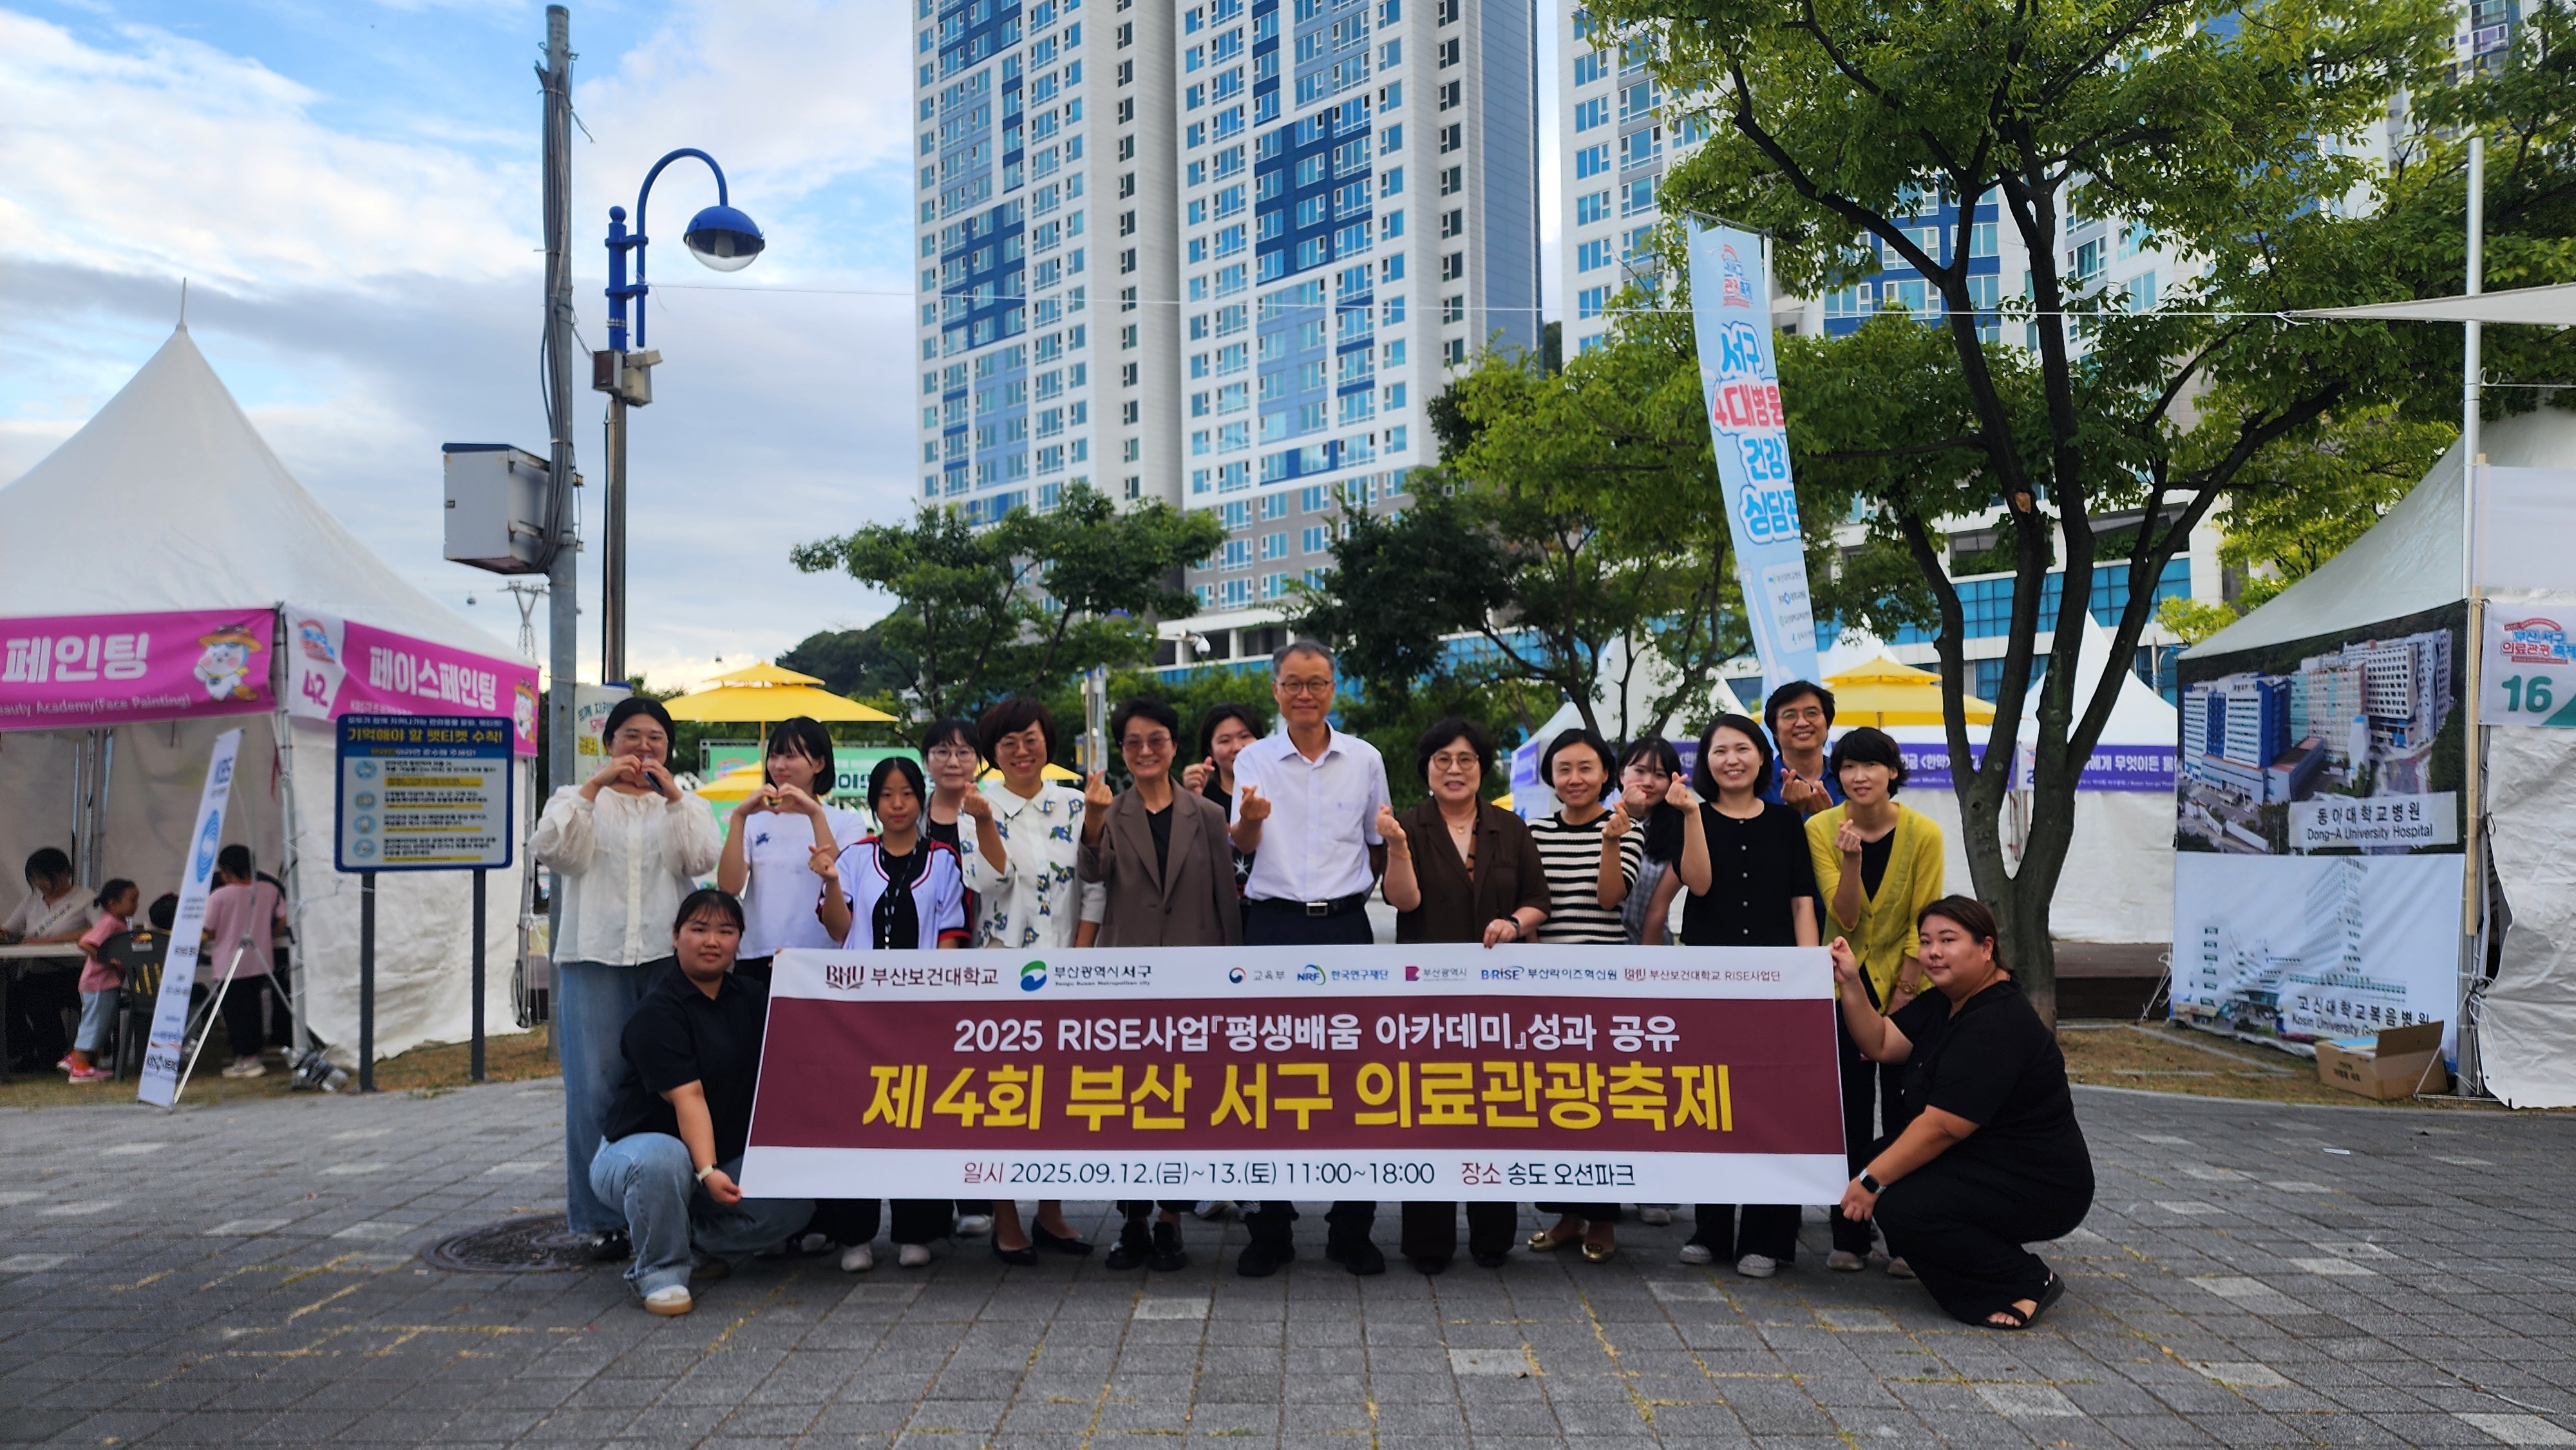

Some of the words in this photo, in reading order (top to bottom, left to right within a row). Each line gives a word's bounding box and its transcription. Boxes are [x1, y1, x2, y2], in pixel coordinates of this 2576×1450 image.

[1721, 330, 1759, 374] 서구
[1744, 438, 1785, 480] 건강
[2, 632, 149, 683] 페인팅
[302, 669, 328, 707] 42
[369, 646, 497, 711] 페이스페인팅
[2501, 675, 2552, 713] 16
[0, 702, 30, 718] eauty
[2084, 755, 2112, 771] 에게
[2115, 755, 2159, 772] 무엇이든
[2318, 802, 2420, 825] 동아대학교병원
[2308, 827, 2342, 842] Dong-A
[2345, 827, 2389, 840] University
[2393, 824, 2432, 838] Hospital
[871, 967, 999, 987] 부산보건대학교
[1055, 966, 1119, 979] 부산광역시
[1122, 965, 1152, 978] 서구
[1253, 970, 1285, 981] 교육부
[1297, 972, 1320, 981] NRF
[1331, 970, 1388, 981] 한국연구재단
[1424, 968, 1466, 977] 부산광역시
[1528, 968, 1617, 980] 부산라이즈혁신원
[1650, 970, 1721, 981] 부산보건대학교
[1725, 970, 1780, 982] RISE사업단
[954, 1019, 1043, 1051] 2025
[1609, 1015, 1680, 1052] 공유
[2293, 1013, 2314, 1028] Kosin
[2317, 1016, 2358, 1037] University
[862, 1064, 1044, 1129] 제4회
[1066, 1064, 1192, 1131] 부산
[1211, 1063, 1333, 1130] 서구
[1355, 1060, 1732, 1131] 의료관광축제
[964, 1162, 1003, 1184] 일시
[1009, 1161, 1277, 1185] 2025.09.12.(금)~13.(토)
[1286, 1162, 1435, 1185] 11:00~18:00
[1461, 1162, 1502, 1185] 장소
[1508, 1162, 1548, 1186] 송도
[1554, 1163, 1636, 1187] 오션파크
